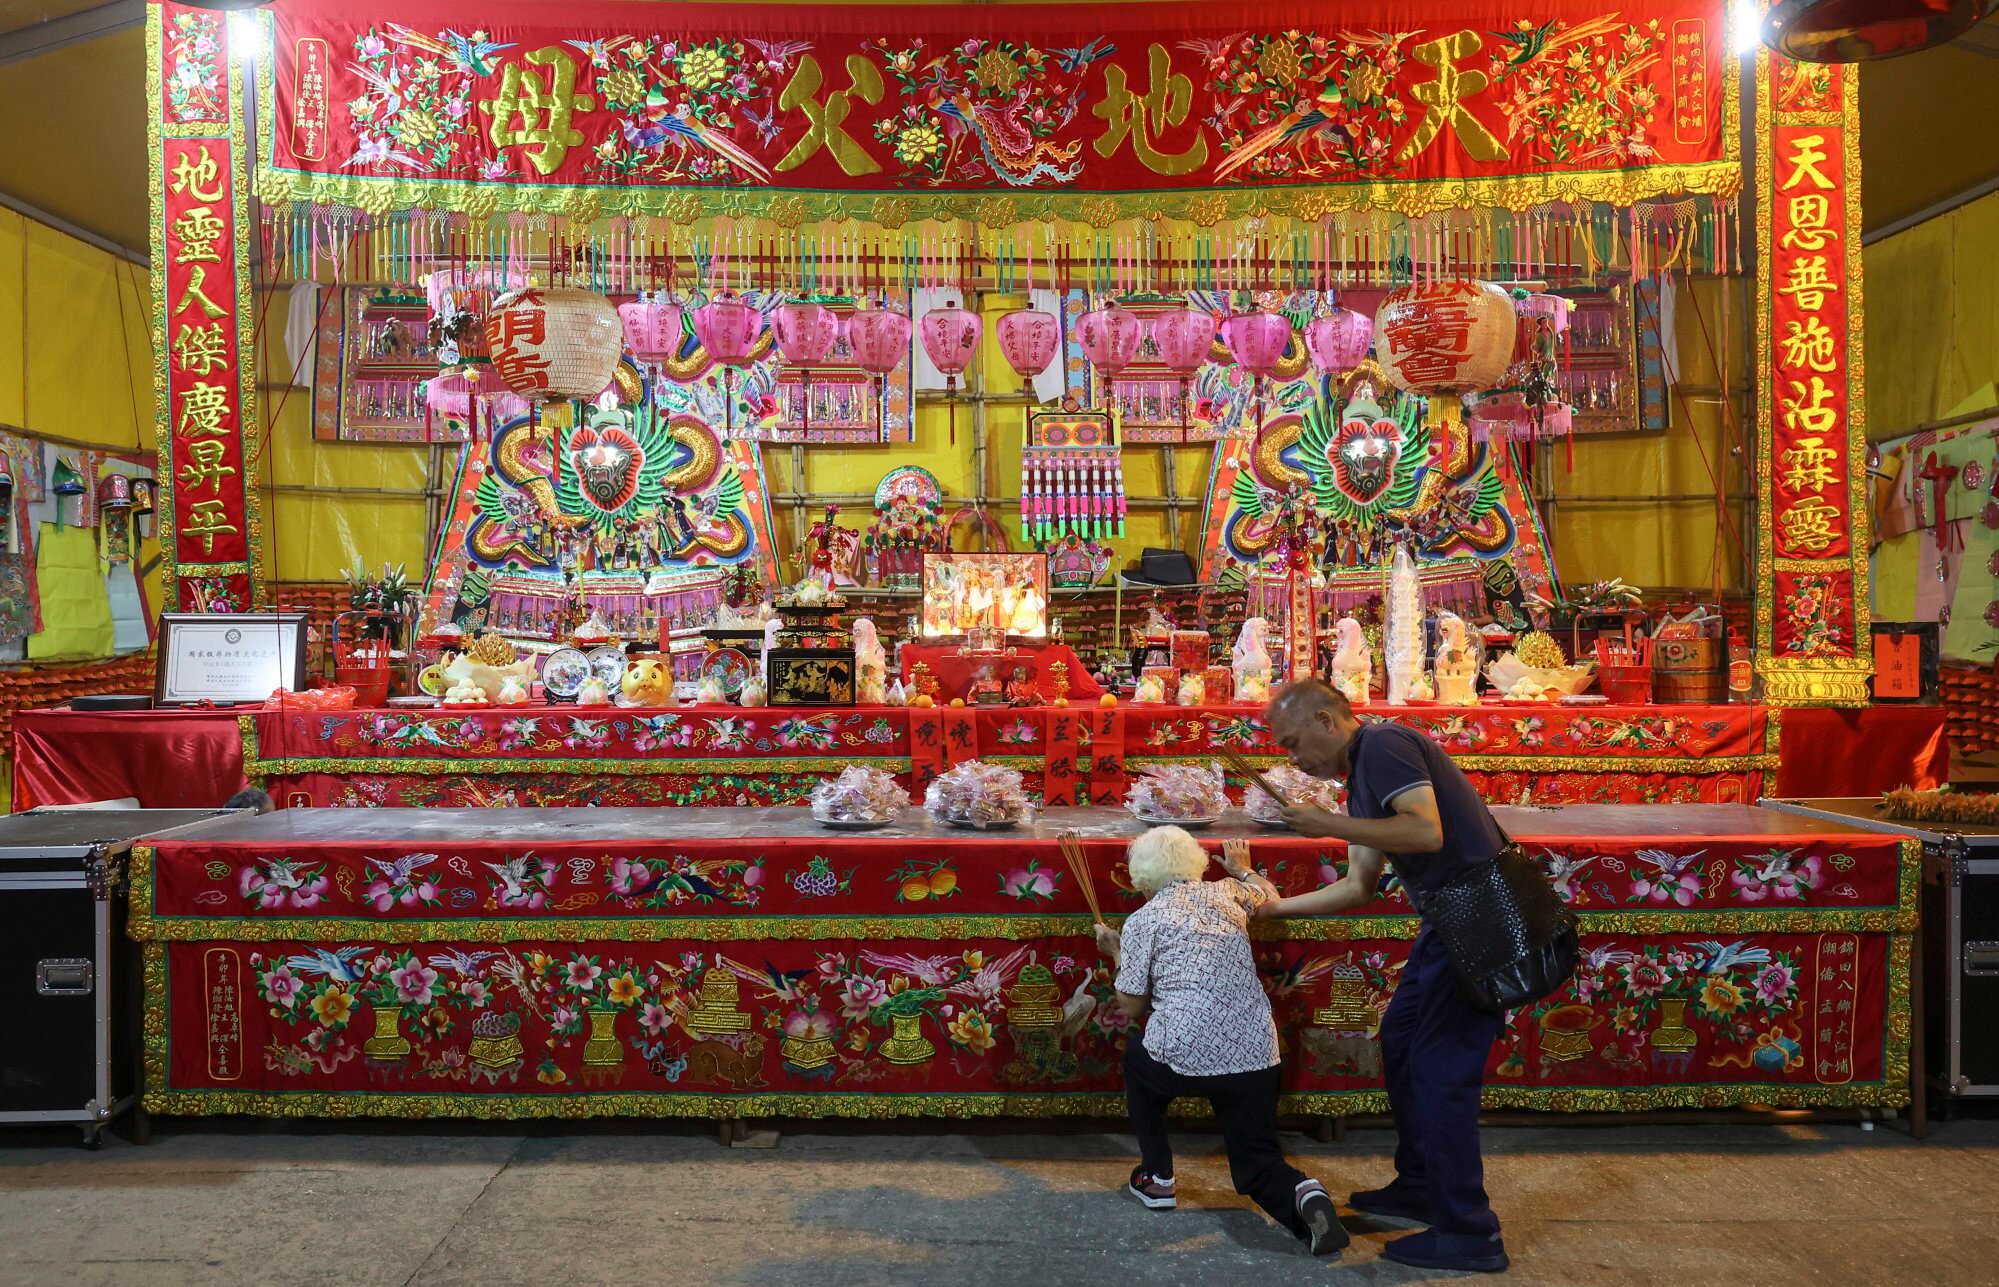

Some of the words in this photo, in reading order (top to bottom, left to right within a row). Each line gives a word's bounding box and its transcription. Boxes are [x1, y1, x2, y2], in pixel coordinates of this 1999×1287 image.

[171, 144, 238, 557] 地靈人傑慶昇平
[1777, 134, 1842, 553] 天恩普施沾霖露
